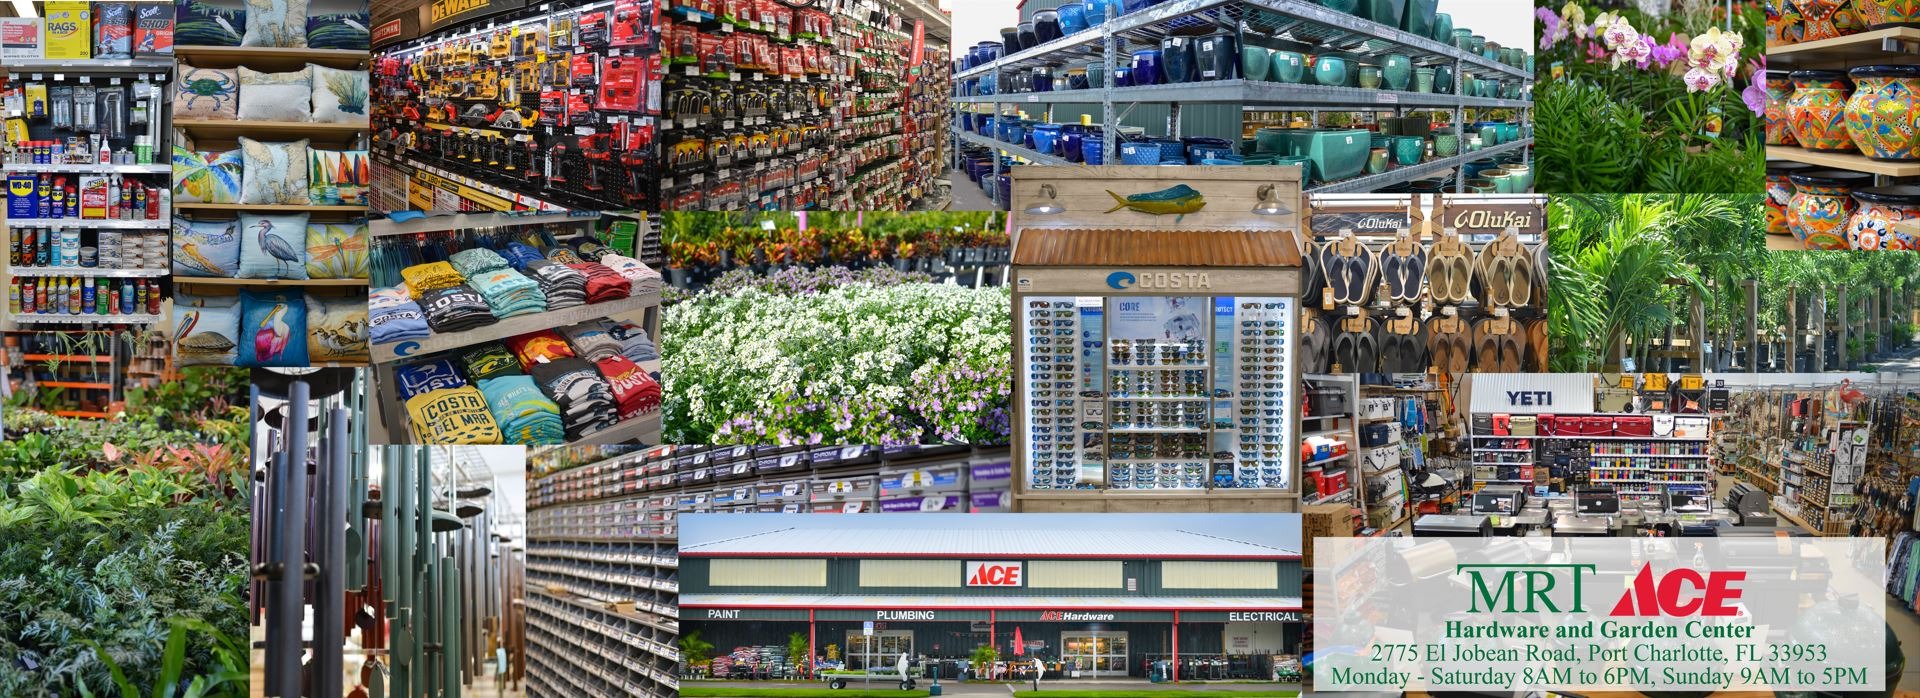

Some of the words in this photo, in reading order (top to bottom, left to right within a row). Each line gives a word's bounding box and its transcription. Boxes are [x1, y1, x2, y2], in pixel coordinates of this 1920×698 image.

[431, 0, 489, 21] DEWA
[48, 22, 77, 31] RAGS
[139, 19, 170, 29] SHOP
[12, 181, 31, 190] WD-40
[1366, 217, 1402, 229] OluKai
[1468, 210, 1532, 229] OluKai
[1139, 272, 1211, 289] COSTA
[1119, 302, 1140, 312] CORE
[1506, 391, 1552, 406] YETI
[427, 396, 480, 420] COSTA
[434, 417, 459, 436] DEL
[813, 450, 838, 459] CHROME
[969, 563, 1020, 585] ACE
[707, 609, 740, 619] PAINT
[876, 610, 935, 620] PLUMBING
[1040, 611, 1063, 621] ACE
[1063, 611, 1114, 621] Hardware
[1229, 611, 1299, 622] ELECTRICAL
